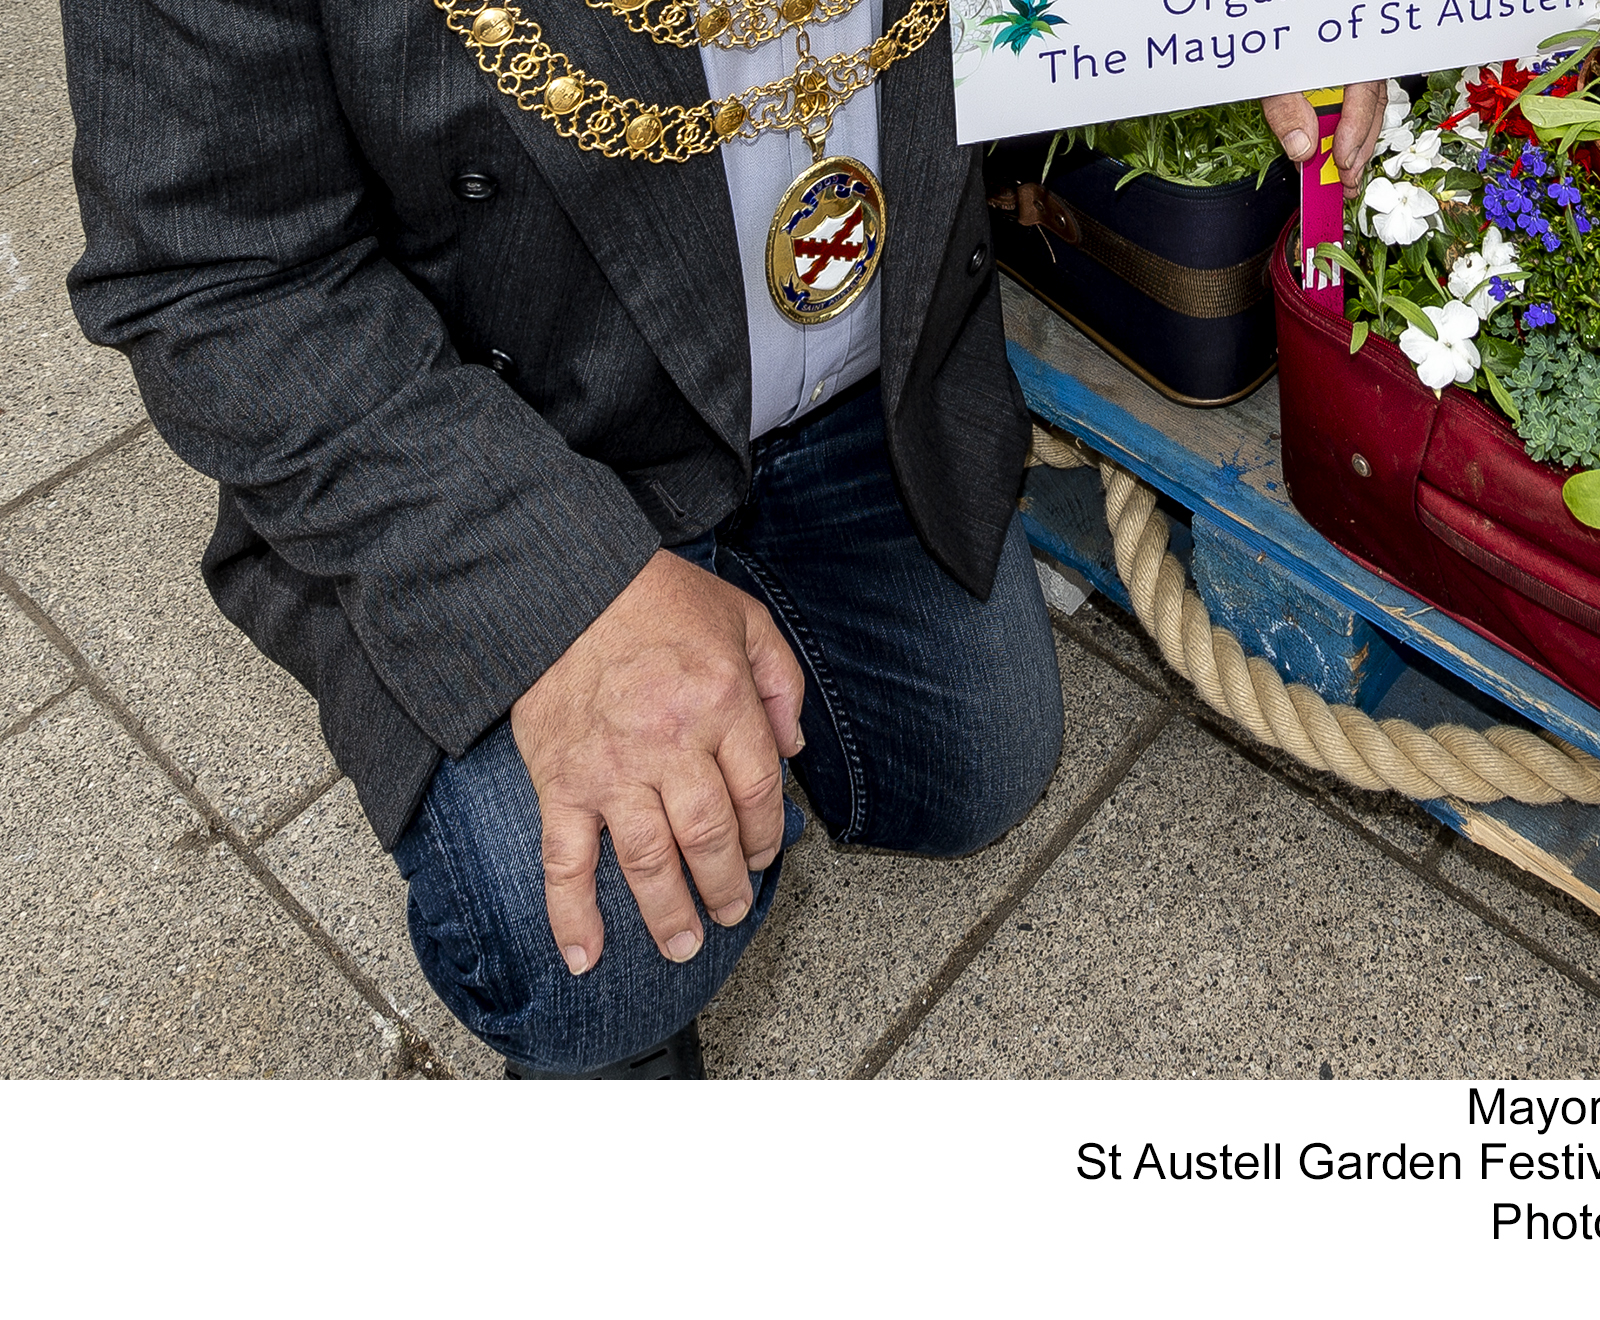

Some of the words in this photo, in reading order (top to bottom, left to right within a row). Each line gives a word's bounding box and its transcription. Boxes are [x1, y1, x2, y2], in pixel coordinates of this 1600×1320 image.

[1038, 43, 1128, 84] The
[1146, 25, 1292, 71] Mayor
[1317, 2, 1368, 44] of
[1379, 1, 1423, 35] St
[811, 174, 839, 196] 1909
[801, 302, 826, 312] SAINT
